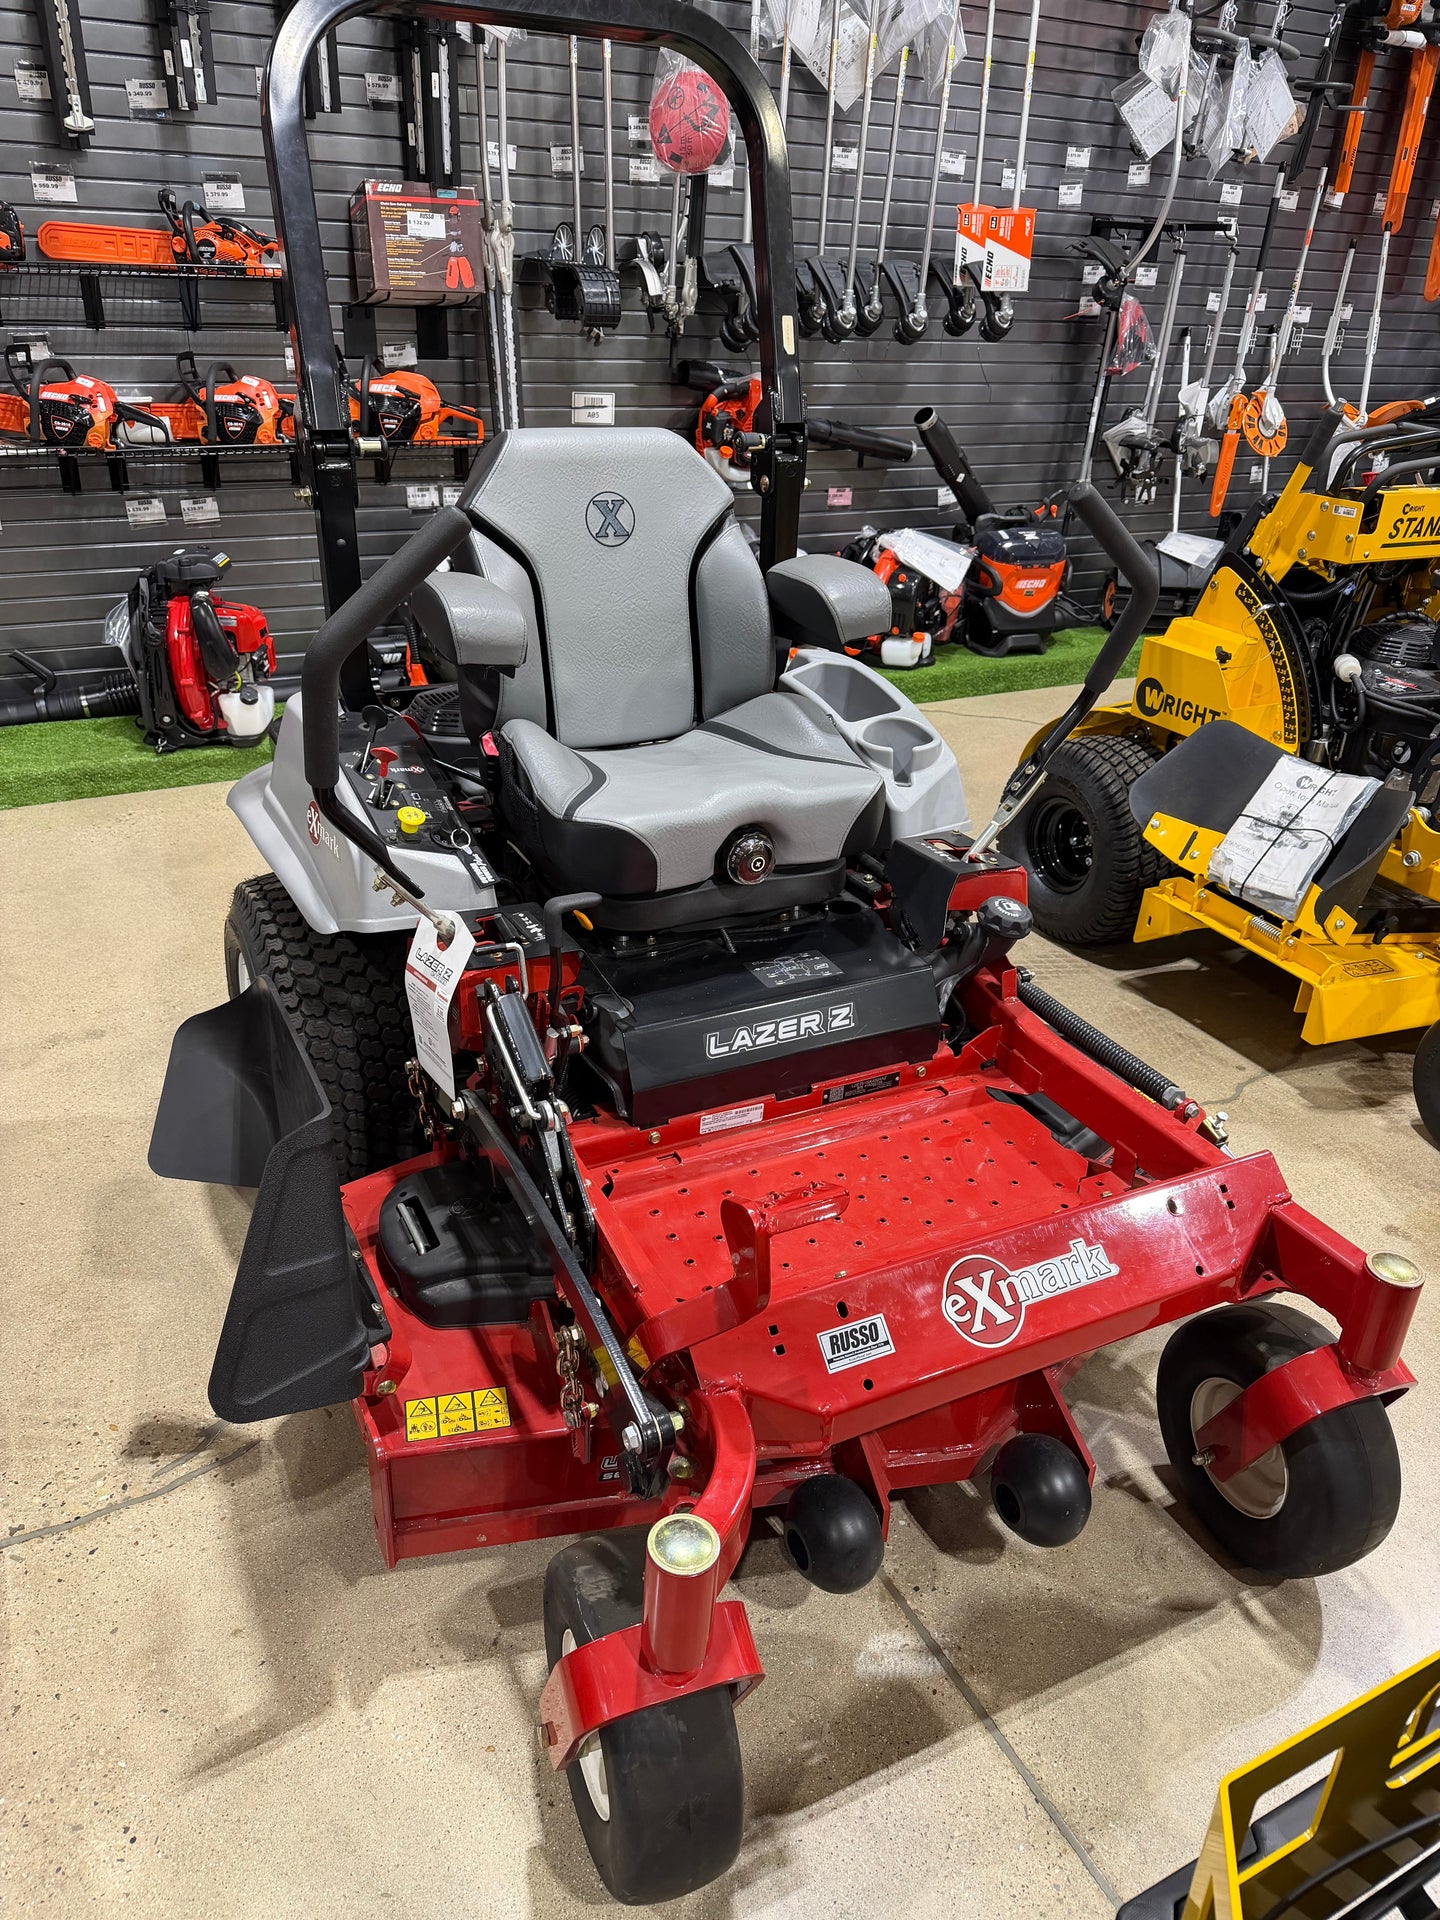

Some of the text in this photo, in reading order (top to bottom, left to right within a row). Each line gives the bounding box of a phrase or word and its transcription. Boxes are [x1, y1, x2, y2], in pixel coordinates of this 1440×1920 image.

[377, 183, 403, 193] ECHO
[986, 250, 995, 280] ECHO
[47, 391, 69, 401] ECHO
[1402, 503, 1426, 515] WRIGHT
[1020, 578, 1048, 588] ECHO
[1280, 676, 1286, 684] 3
[1137, 678, 1221, 726] WRIGHT
[415, 948, 445, 978] LAZER
[705, 1002, 855, 1062] LAZER Z
[943, 1239, 1114, 1343] eXmark
[829, 1321, 880, 1356] RUSSO
